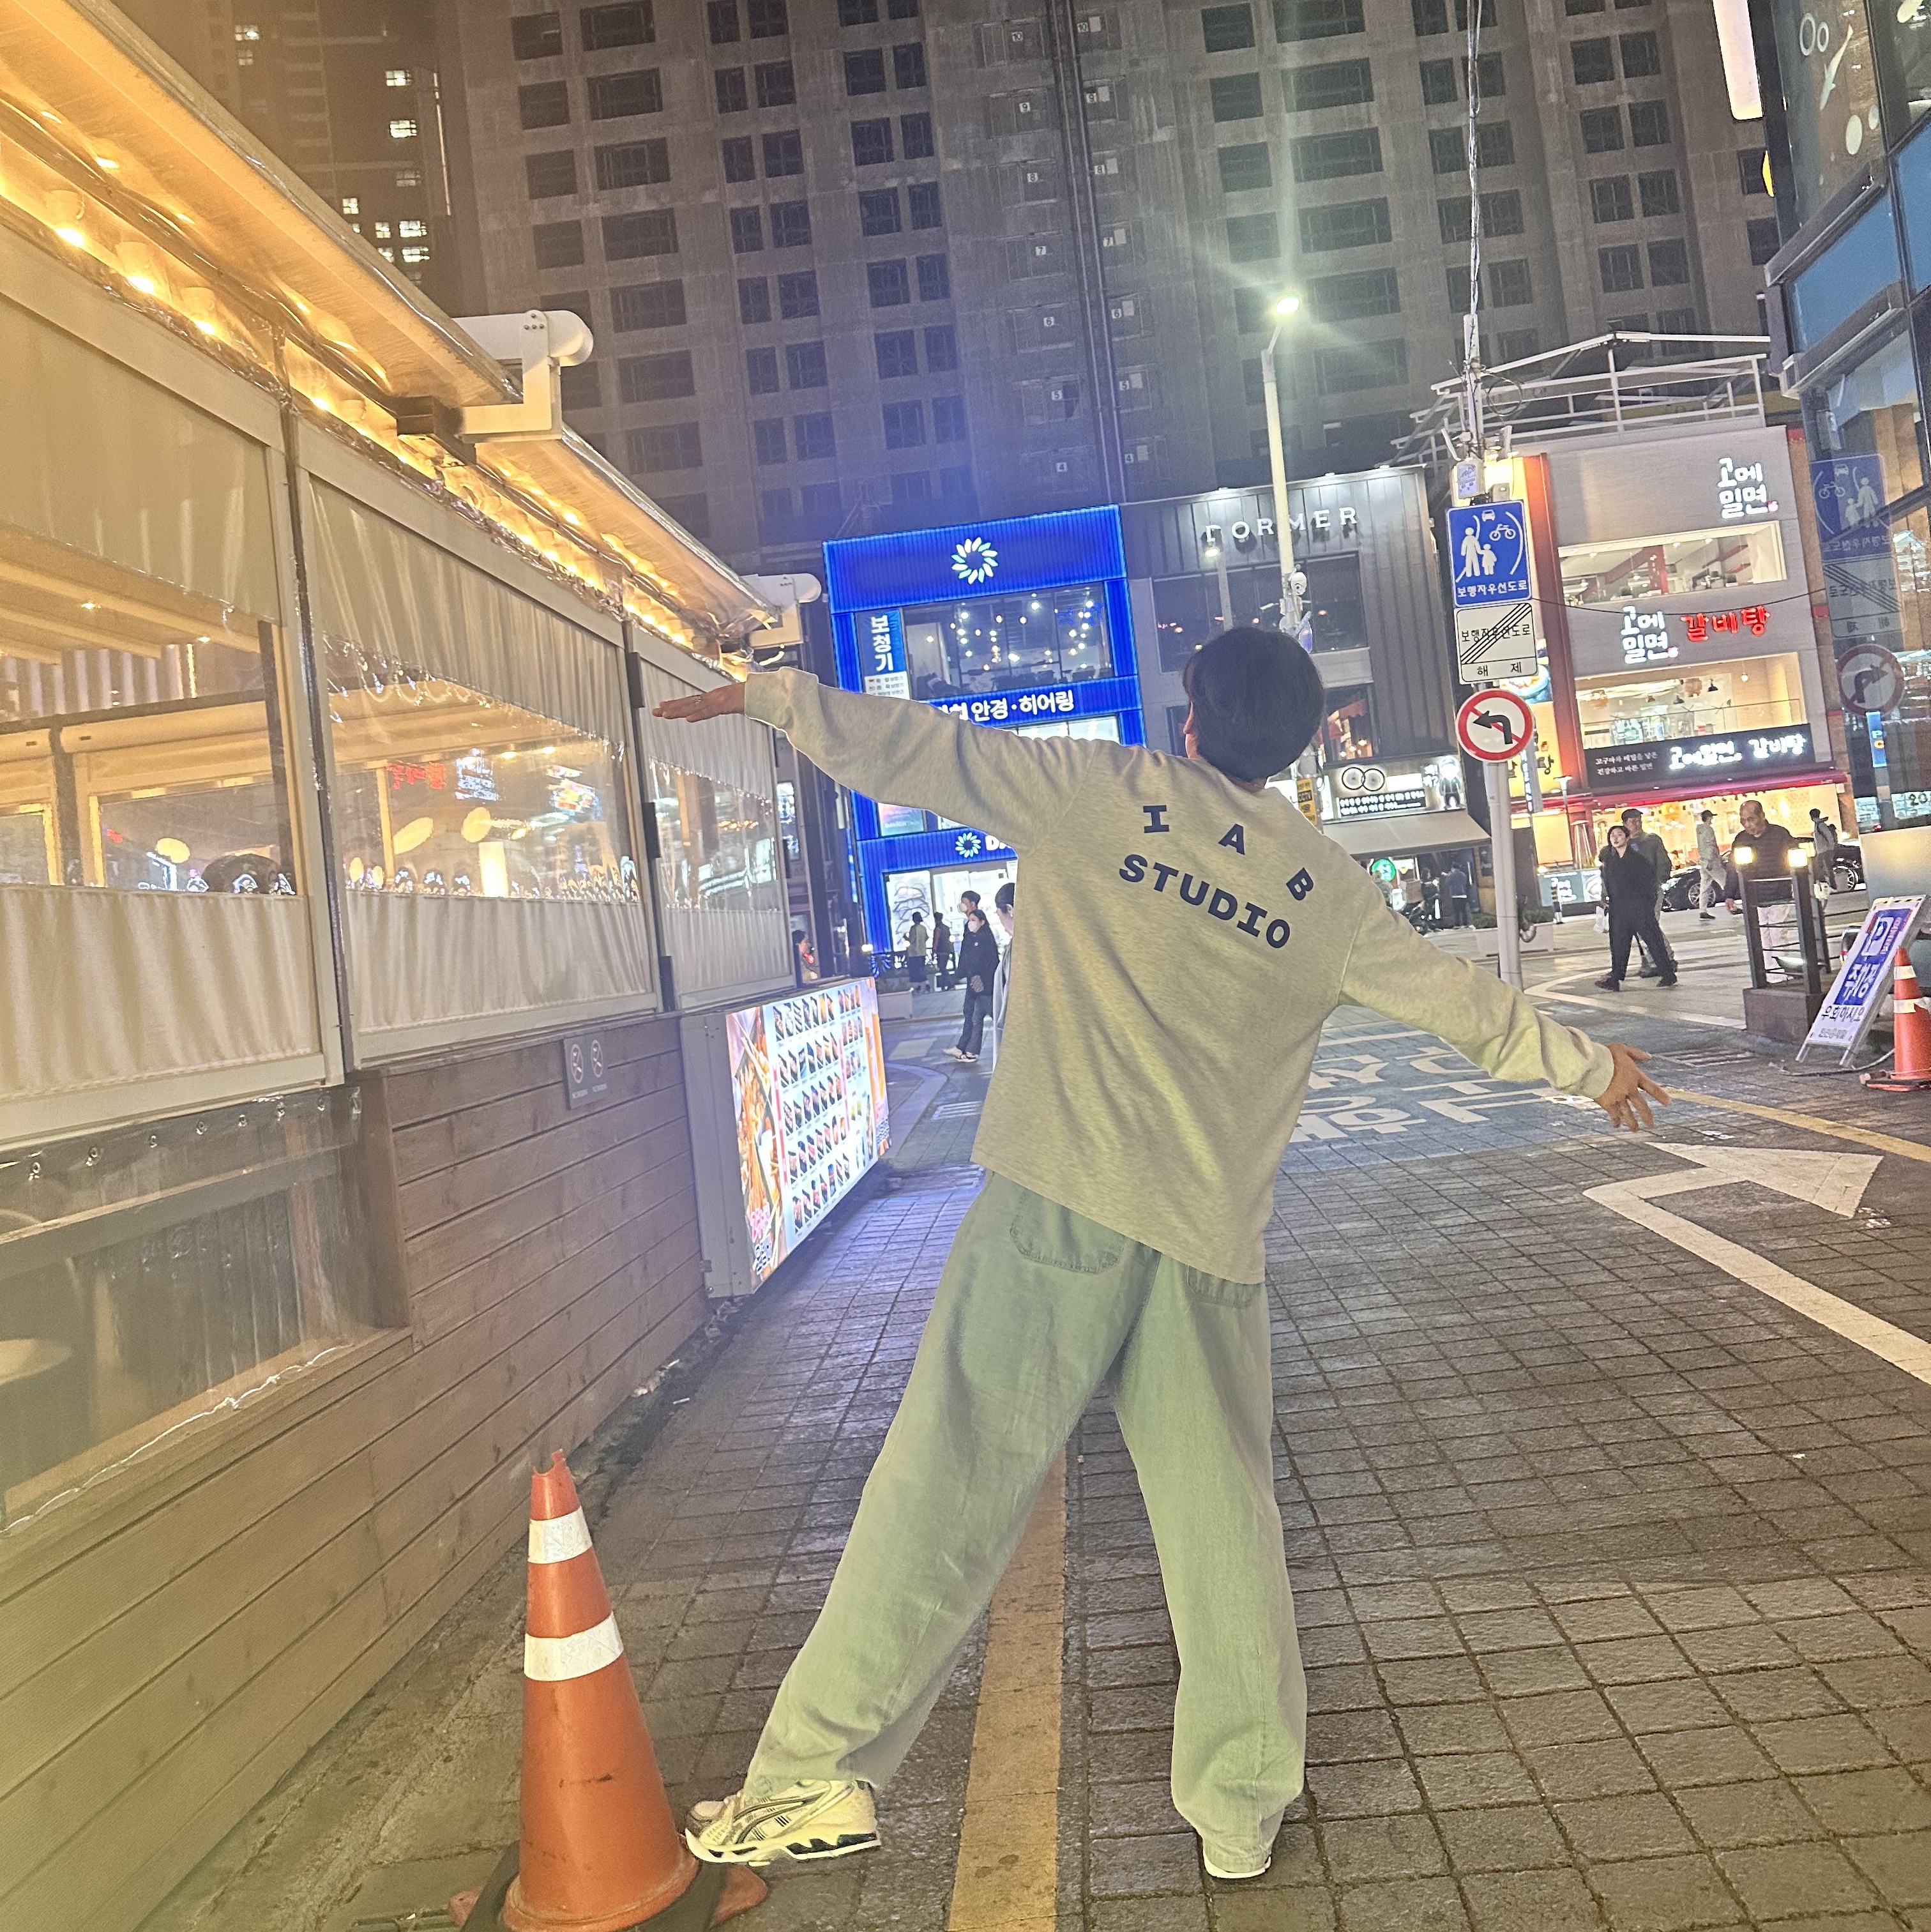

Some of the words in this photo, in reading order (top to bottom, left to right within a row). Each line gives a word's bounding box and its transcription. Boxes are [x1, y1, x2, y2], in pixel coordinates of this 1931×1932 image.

[1457, 580, 1528, 598] 보행자우선도로
[871, 615, 893, 671] 보청기
[1680, 605, 1770, 643] 갈비탕
[1748, 734, 1806, 759] 갈비탕
[1119, 854, 1290, 948] STUDIO
